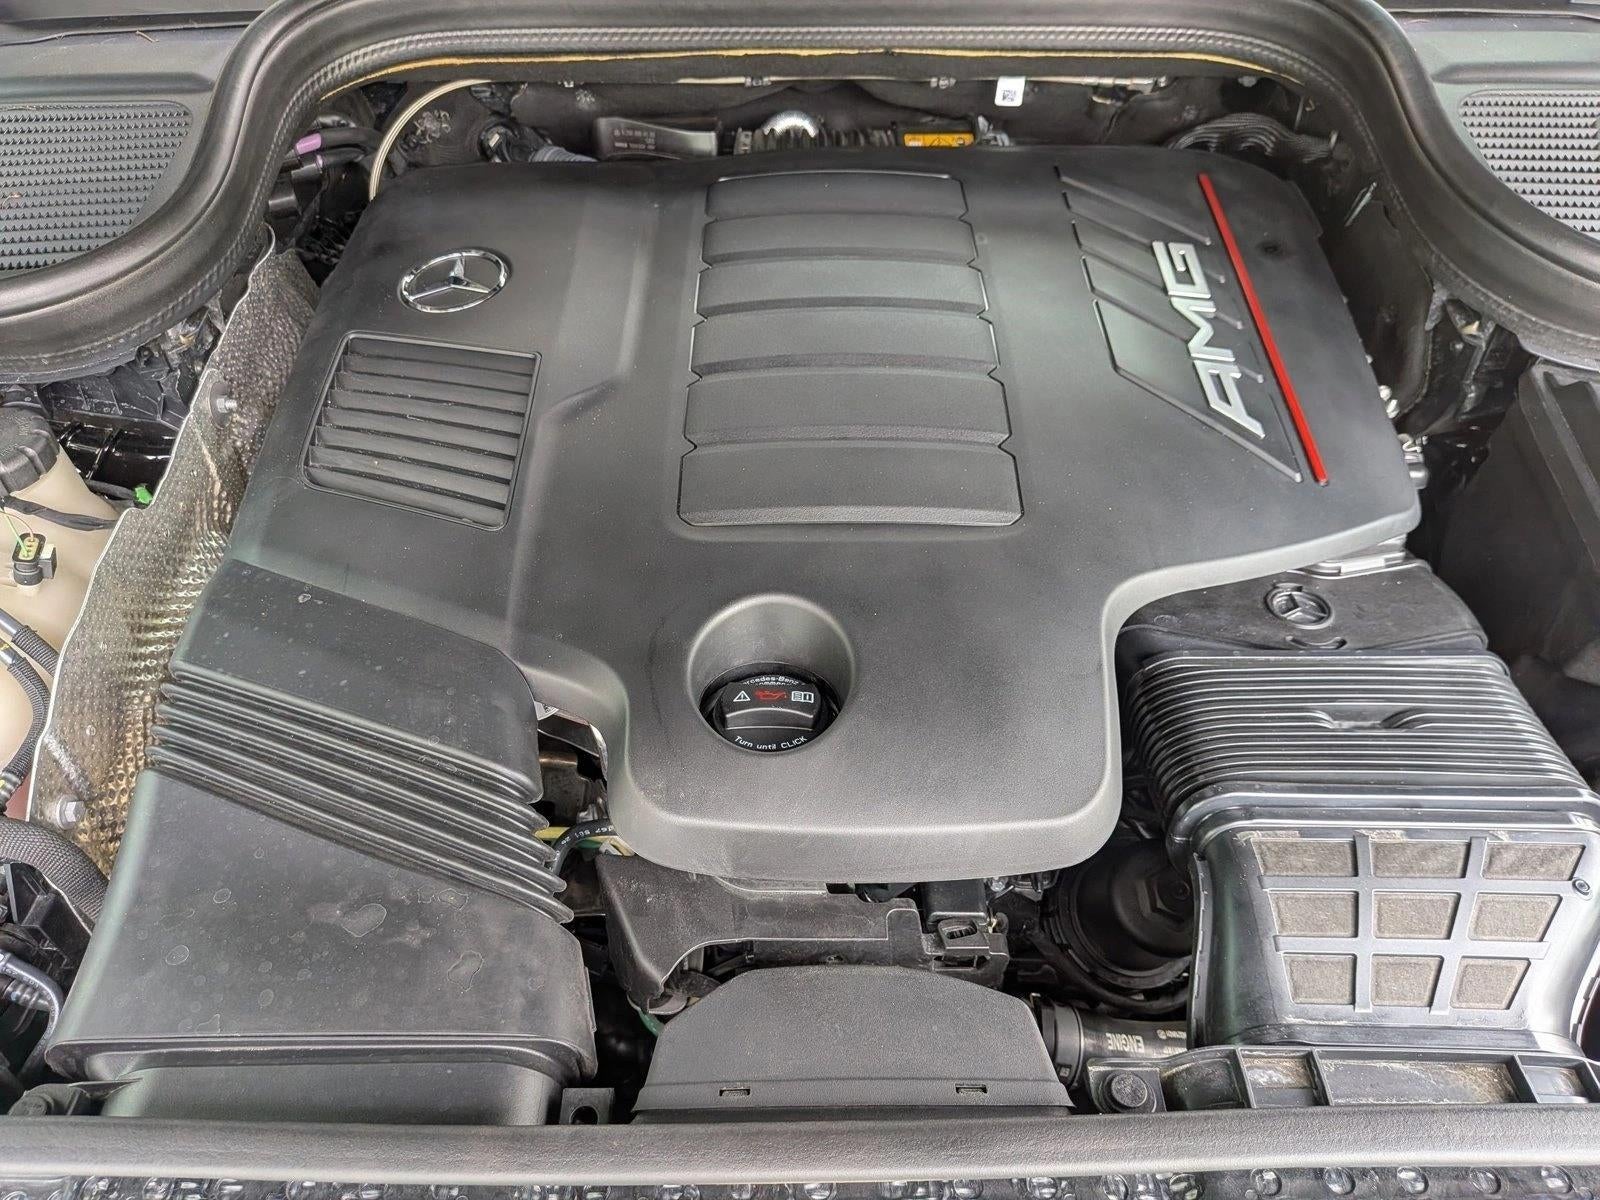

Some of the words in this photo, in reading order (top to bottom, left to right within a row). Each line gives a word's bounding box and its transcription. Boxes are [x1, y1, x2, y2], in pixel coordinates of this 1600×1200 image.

[1152, 240, 1265, 439] AMG
[743, 675, 799, 685] rcedes-Benz
[734, 735, 753, 748] Turn
[781, 736, 808, 749] CLICK
[1106, 1032, 1145, 1054] ENGINE
